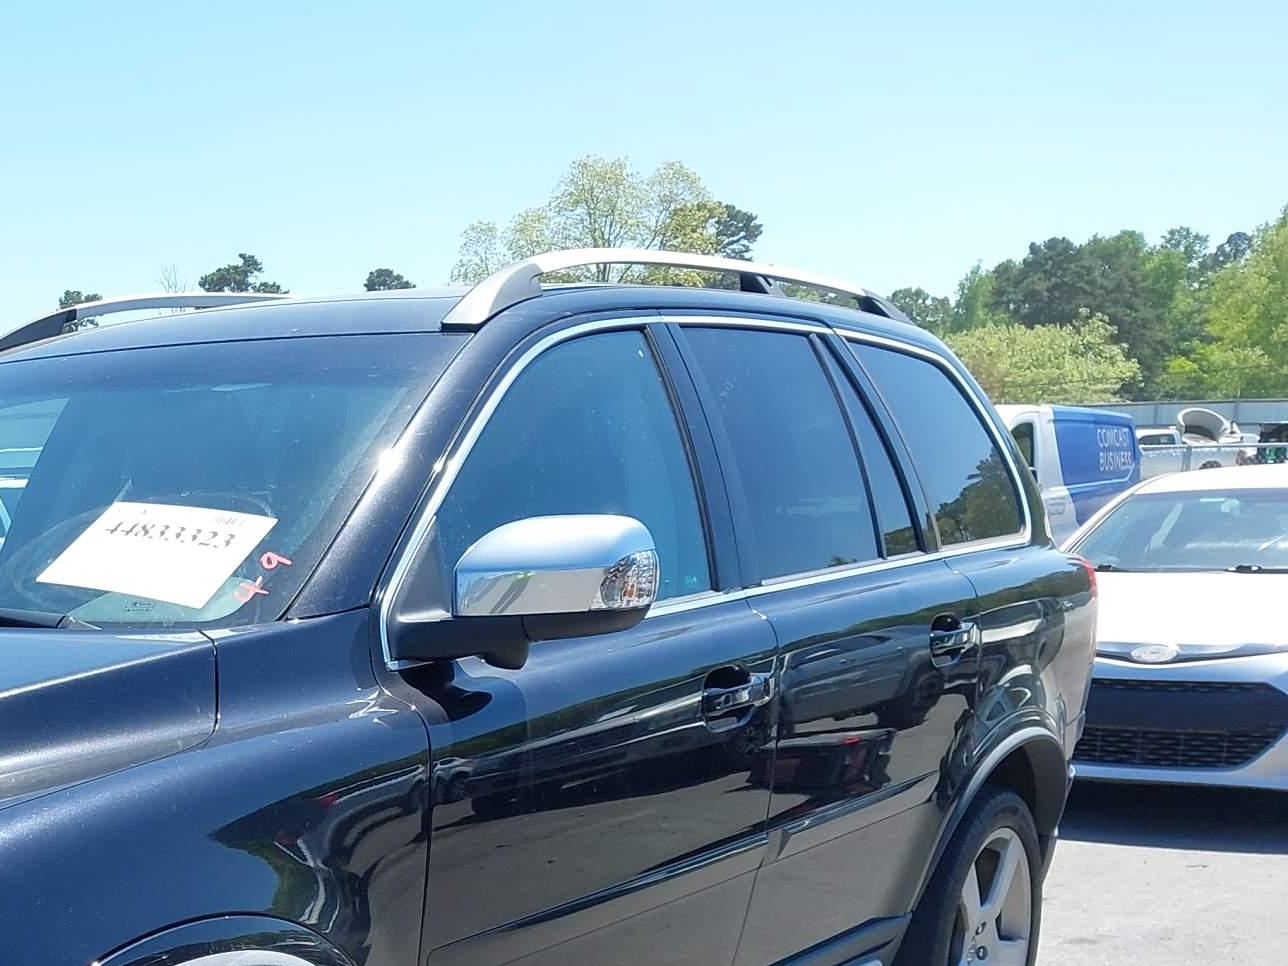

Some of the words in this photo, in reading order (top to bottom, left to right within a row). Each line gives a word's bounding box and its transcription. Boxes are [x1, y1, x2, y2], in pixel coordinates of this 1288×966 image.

[1096, 427, 1130, 448] COMCAST
[1099, 451, 1133, 471] BUSINESS
[104, 520, 237, 549] 44833323
